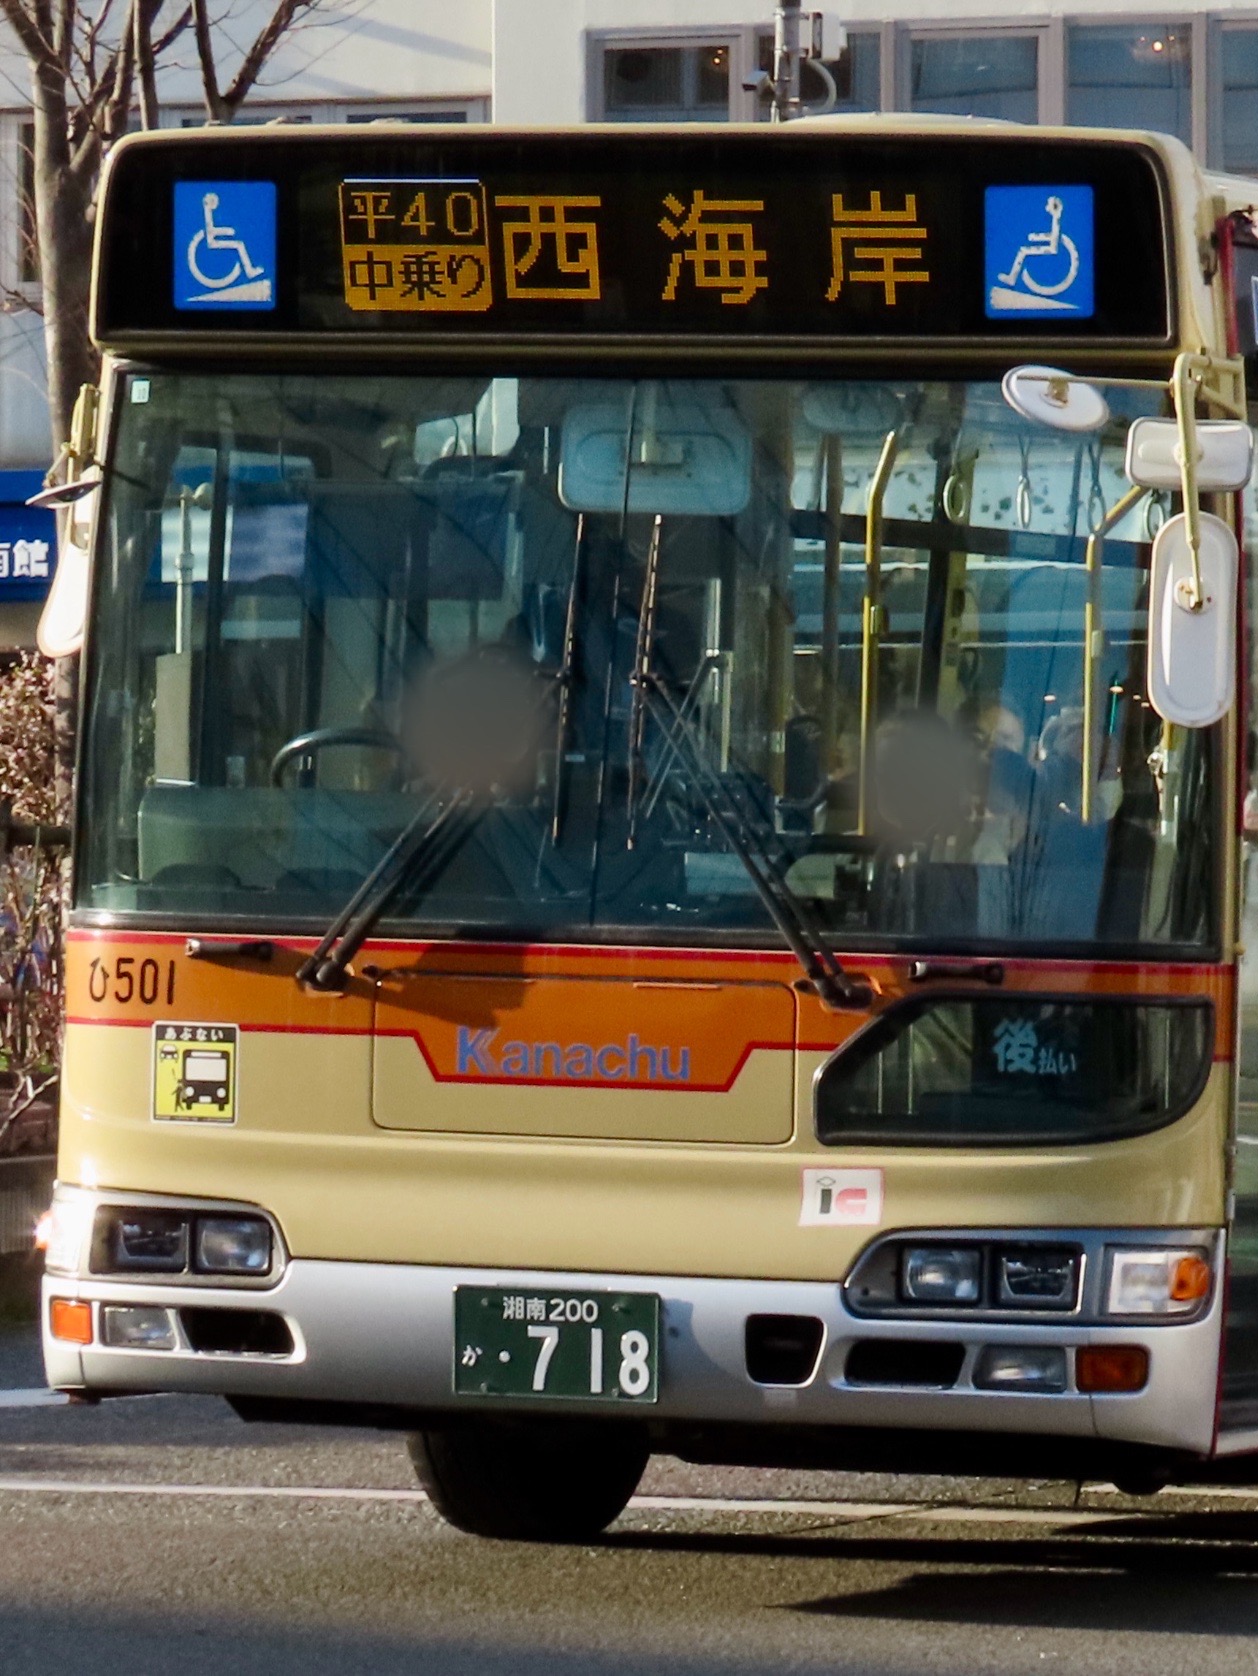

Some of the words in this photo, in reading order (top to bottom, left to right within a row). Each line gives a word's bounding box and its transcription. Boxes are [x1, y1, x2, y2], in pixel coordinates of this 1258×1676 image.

[349, 192, 479, 239] 平40
[495, 190, 930, 305] 西海岸
[350, 251, 488, 301] 中乗り
[89, 957, 175, 1005] ひ501
[165, 1027, 224, 1042] あぶない
[456, 1025, 690, 1080] Kanachu
[993, 1018, 1077, 1075] 後払い
[502, 1295, 599, 1324] 湘南200
